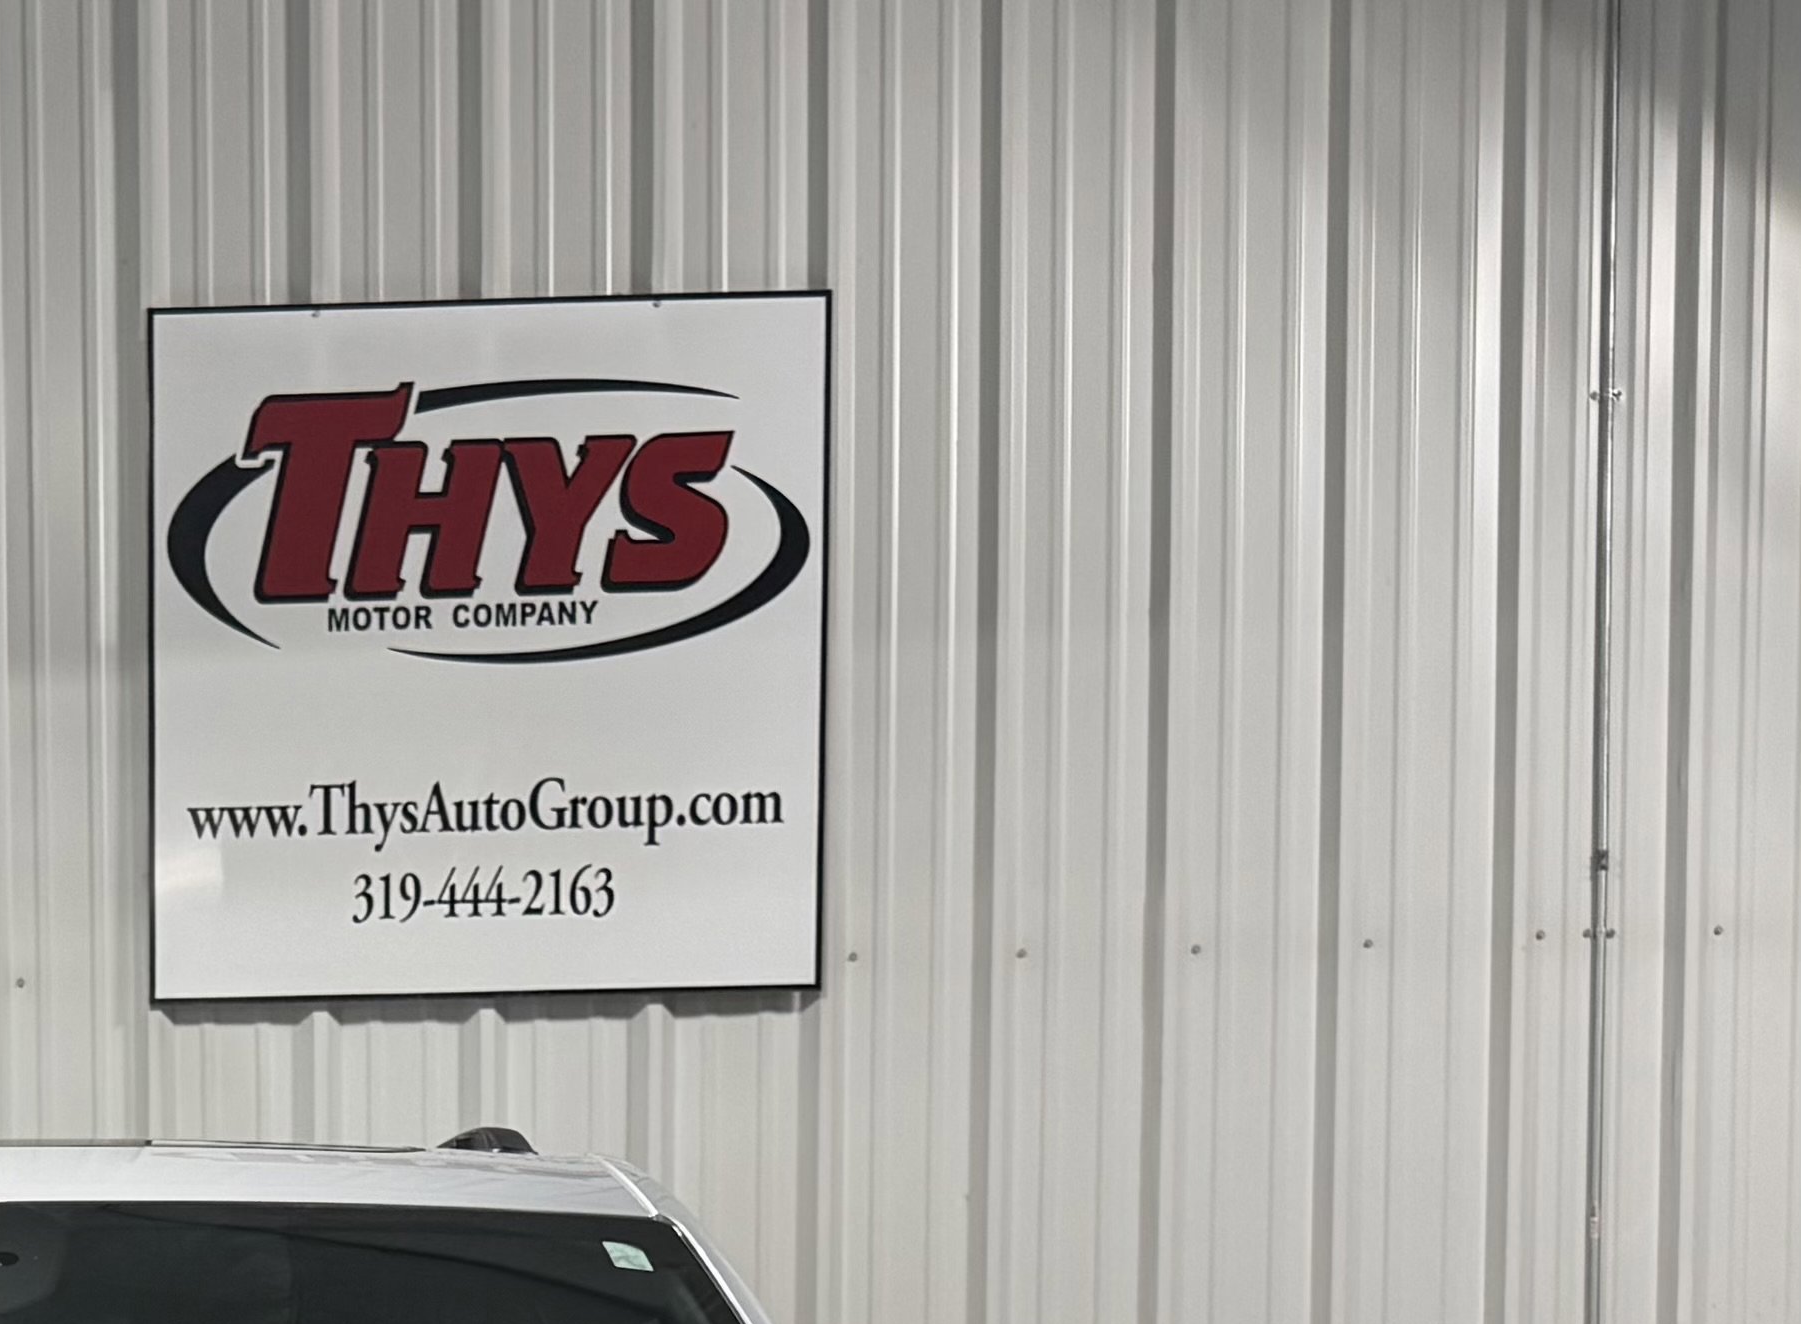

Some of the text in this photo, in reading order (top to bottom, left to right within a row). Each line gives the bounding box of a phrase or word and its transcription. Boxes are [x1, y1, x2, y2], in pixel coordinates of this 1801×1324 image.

[241, 382, 735, 605] THYS
[328, 600, 599, 633] MOTOR COMPANY
[187, 777, 784, 853] www.ThysAutoGroup.com
[352, 863, 615, 924] 319-444-2163
